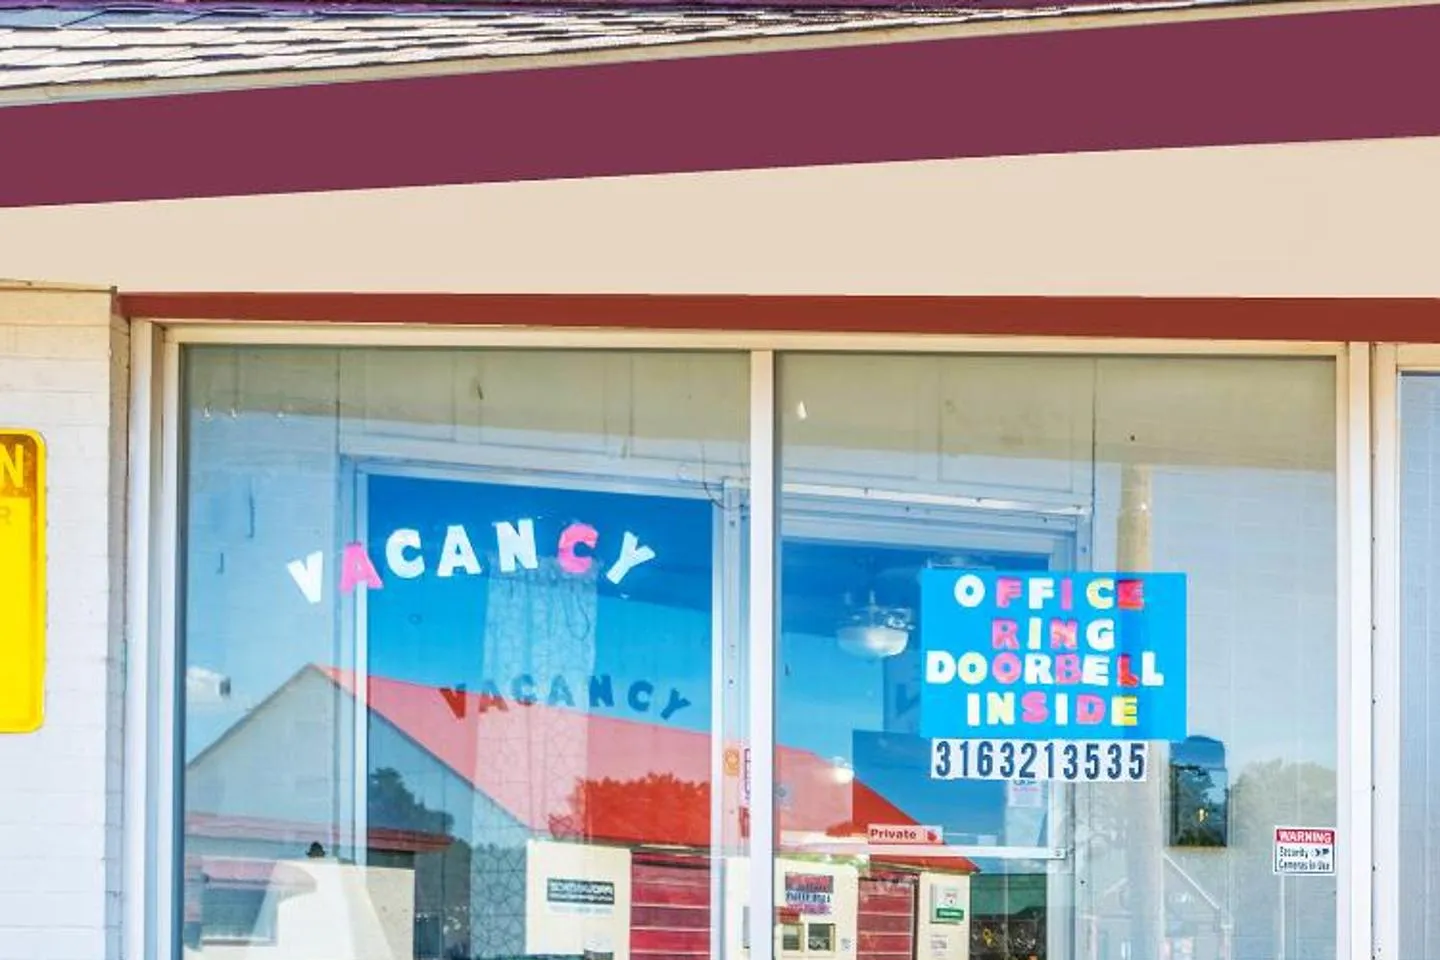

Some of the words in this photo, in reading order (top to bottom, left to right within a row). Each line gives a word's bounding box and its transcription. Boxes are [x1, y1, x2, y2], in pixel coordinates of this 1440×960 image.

[286, 518, 657, 604] VACANCY
[954, 574, 1145, 610] OFFICE
[991, 617, 1115, 650] RING
[926, 650, 1164, 686] DOORBELL
[439, 674, 692, 721] VACANCY
[967, 691, 1138, 726] INSIDE
[935, 740, 1145, 781] 3163213535
[870, 828, 917, 840] Private
[1279, 830, 1332, 844] WARNING
